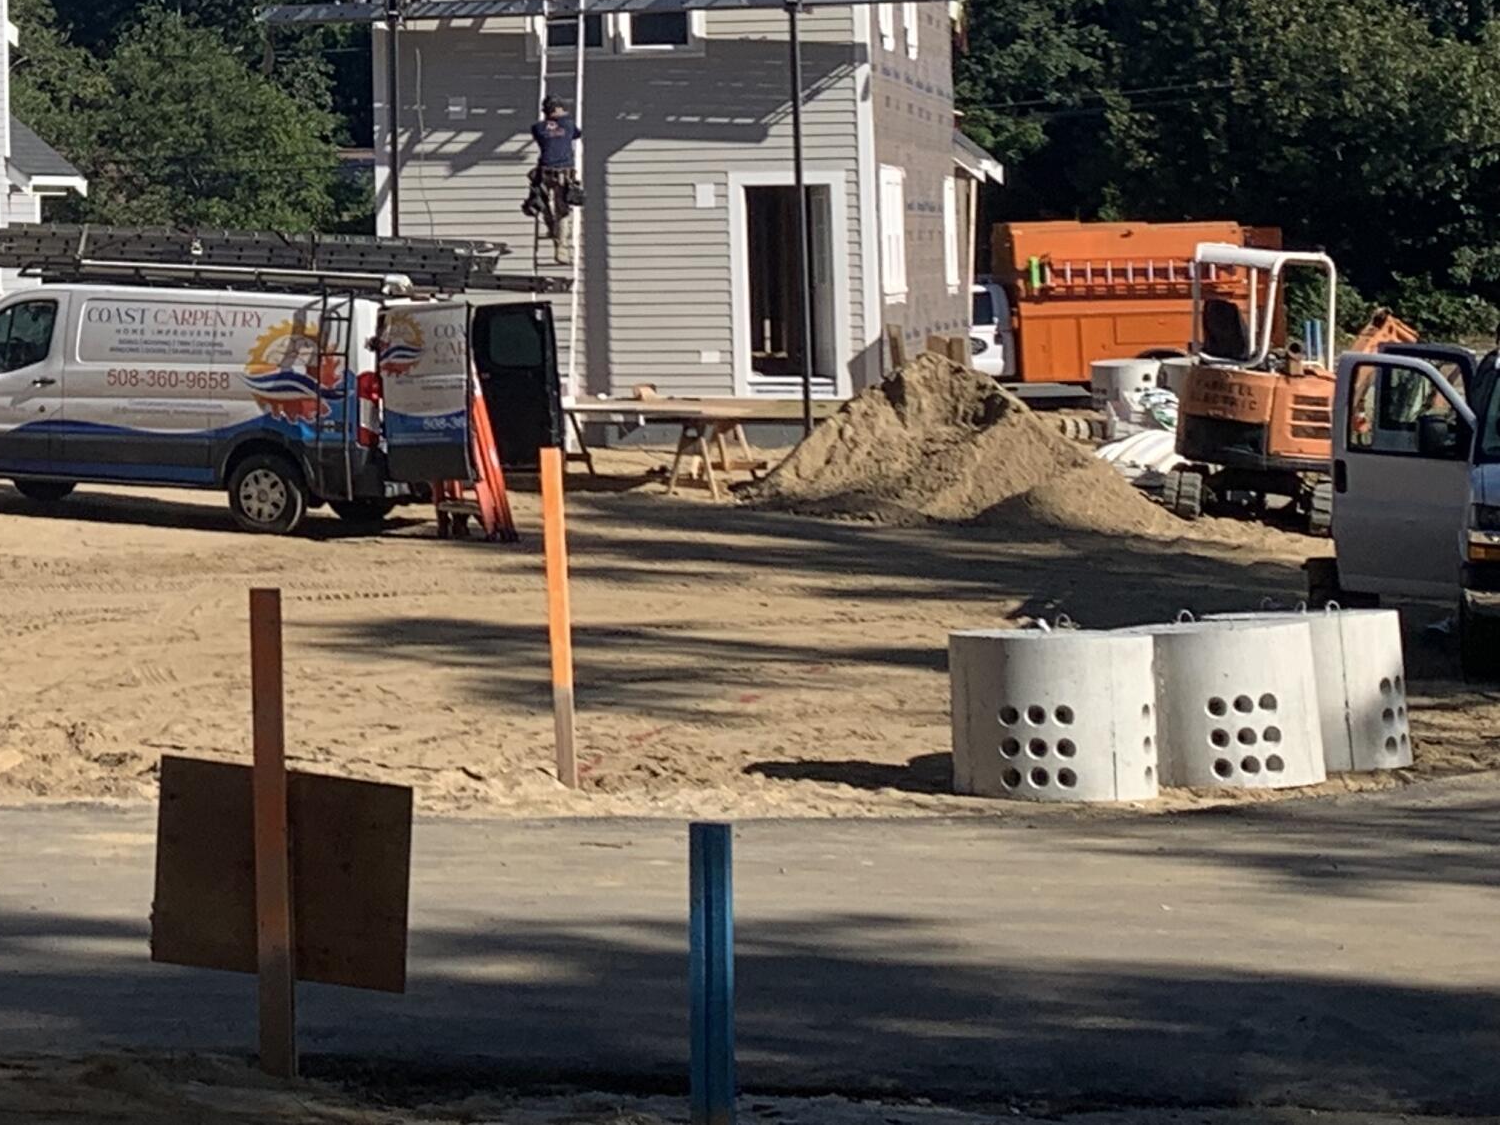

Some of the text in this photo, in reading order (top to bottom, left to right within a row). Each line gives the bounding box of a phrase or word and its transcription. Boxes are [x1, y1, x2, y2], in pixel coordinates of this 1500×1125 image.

[87, 306, 264, 329] COAST CARPENTRY
[107, 368, 230, 390] 508-360-9658
